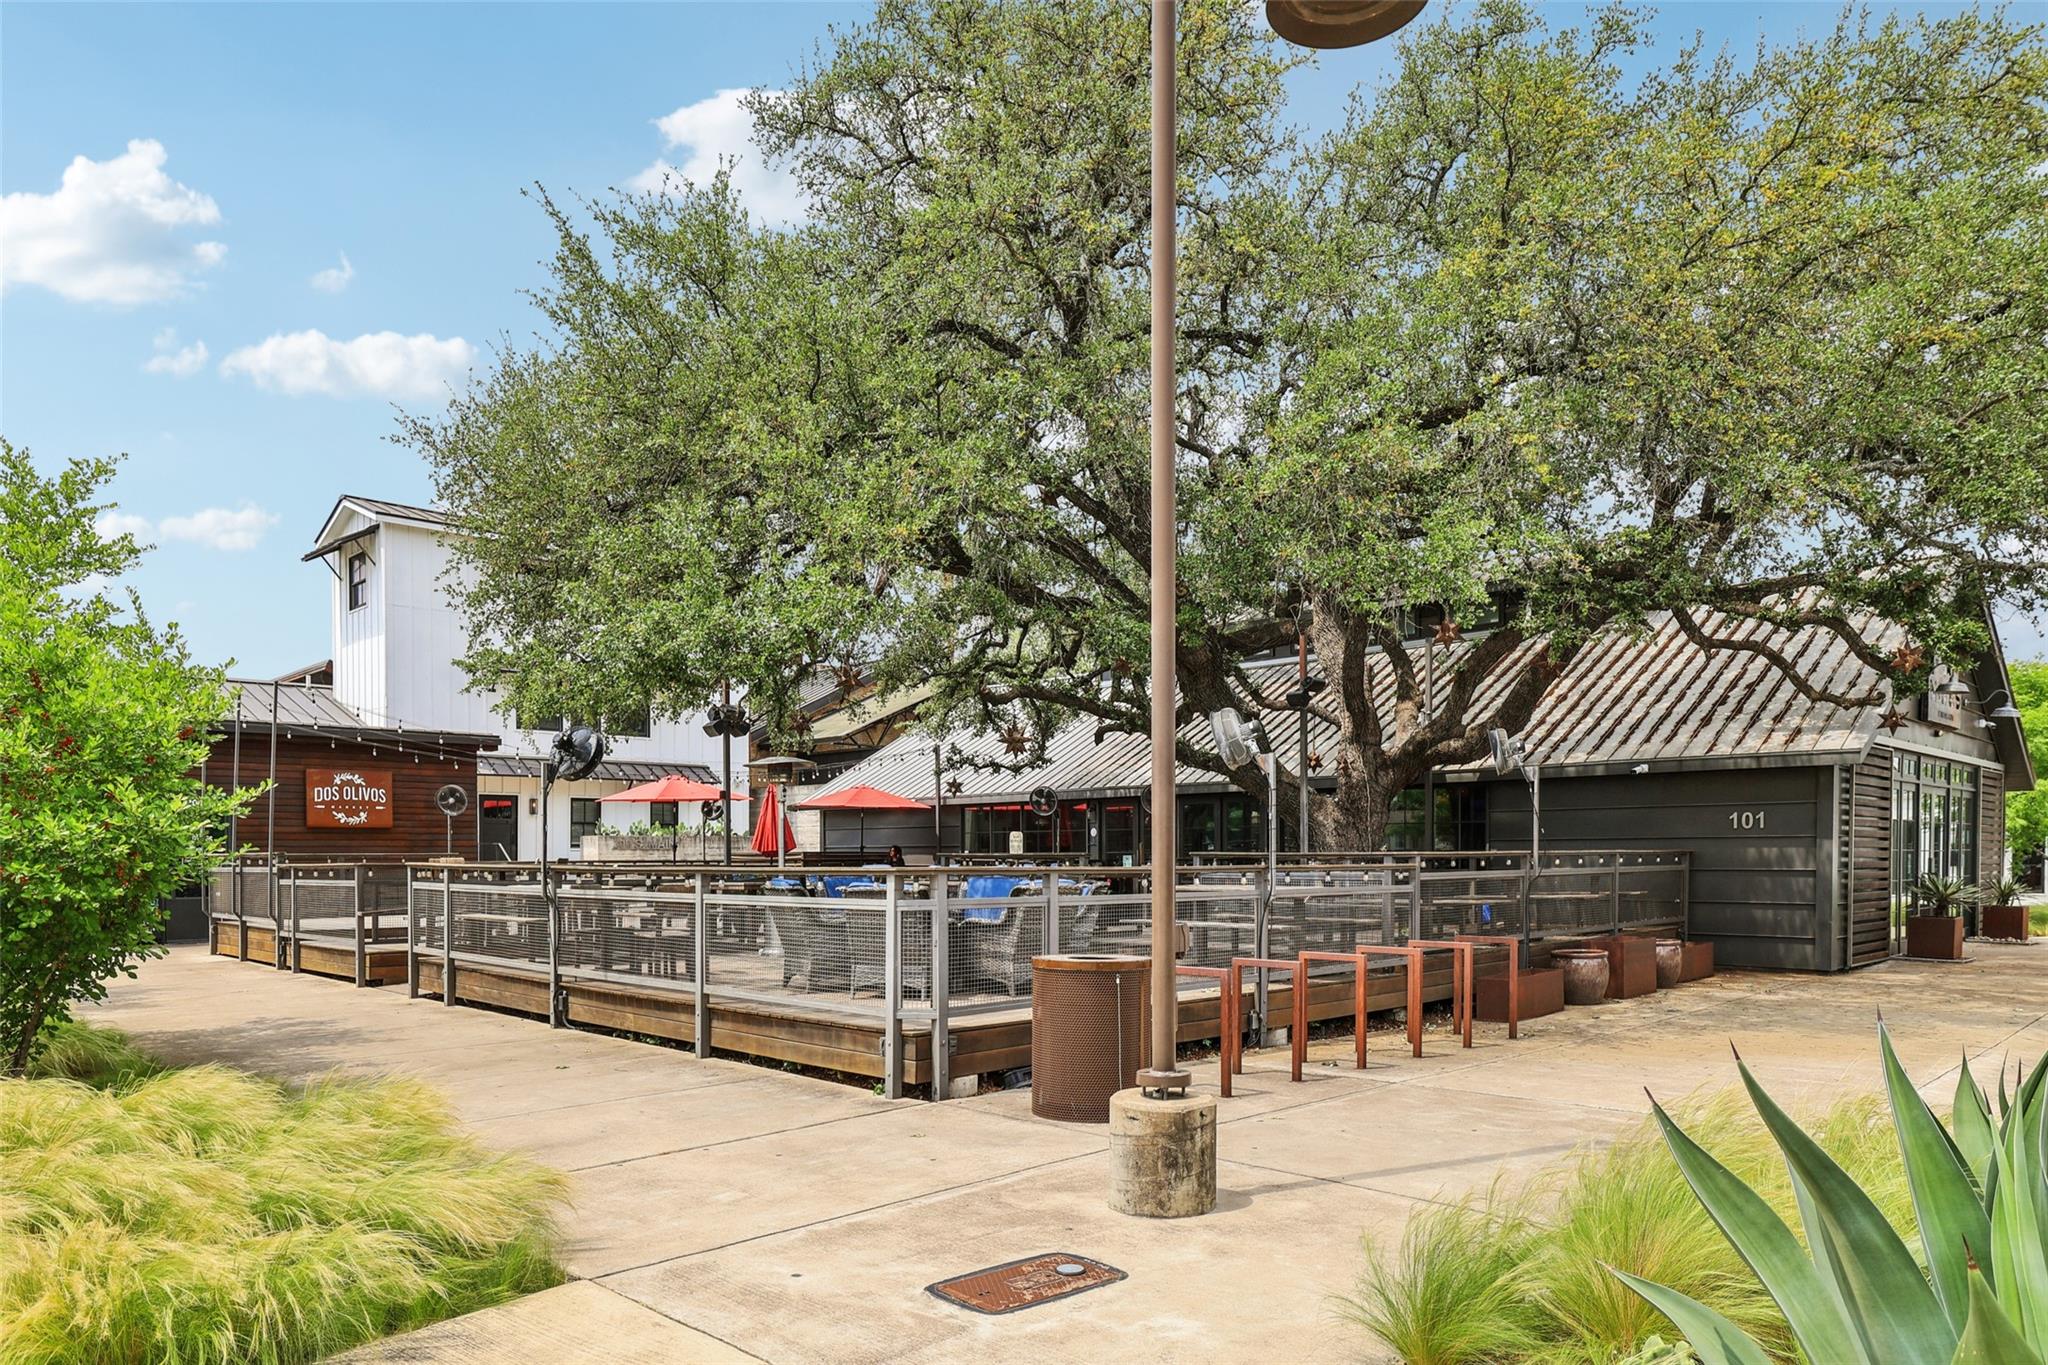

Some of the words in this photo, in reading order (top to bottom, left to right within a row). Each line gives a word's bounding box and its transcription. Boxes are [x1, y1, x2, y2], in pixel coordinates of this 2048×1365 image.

[314, 786, 340, 802] DOS
[343, 786, 386, 803] OLIVOS
[1729, 811, 1764, 829] 101
